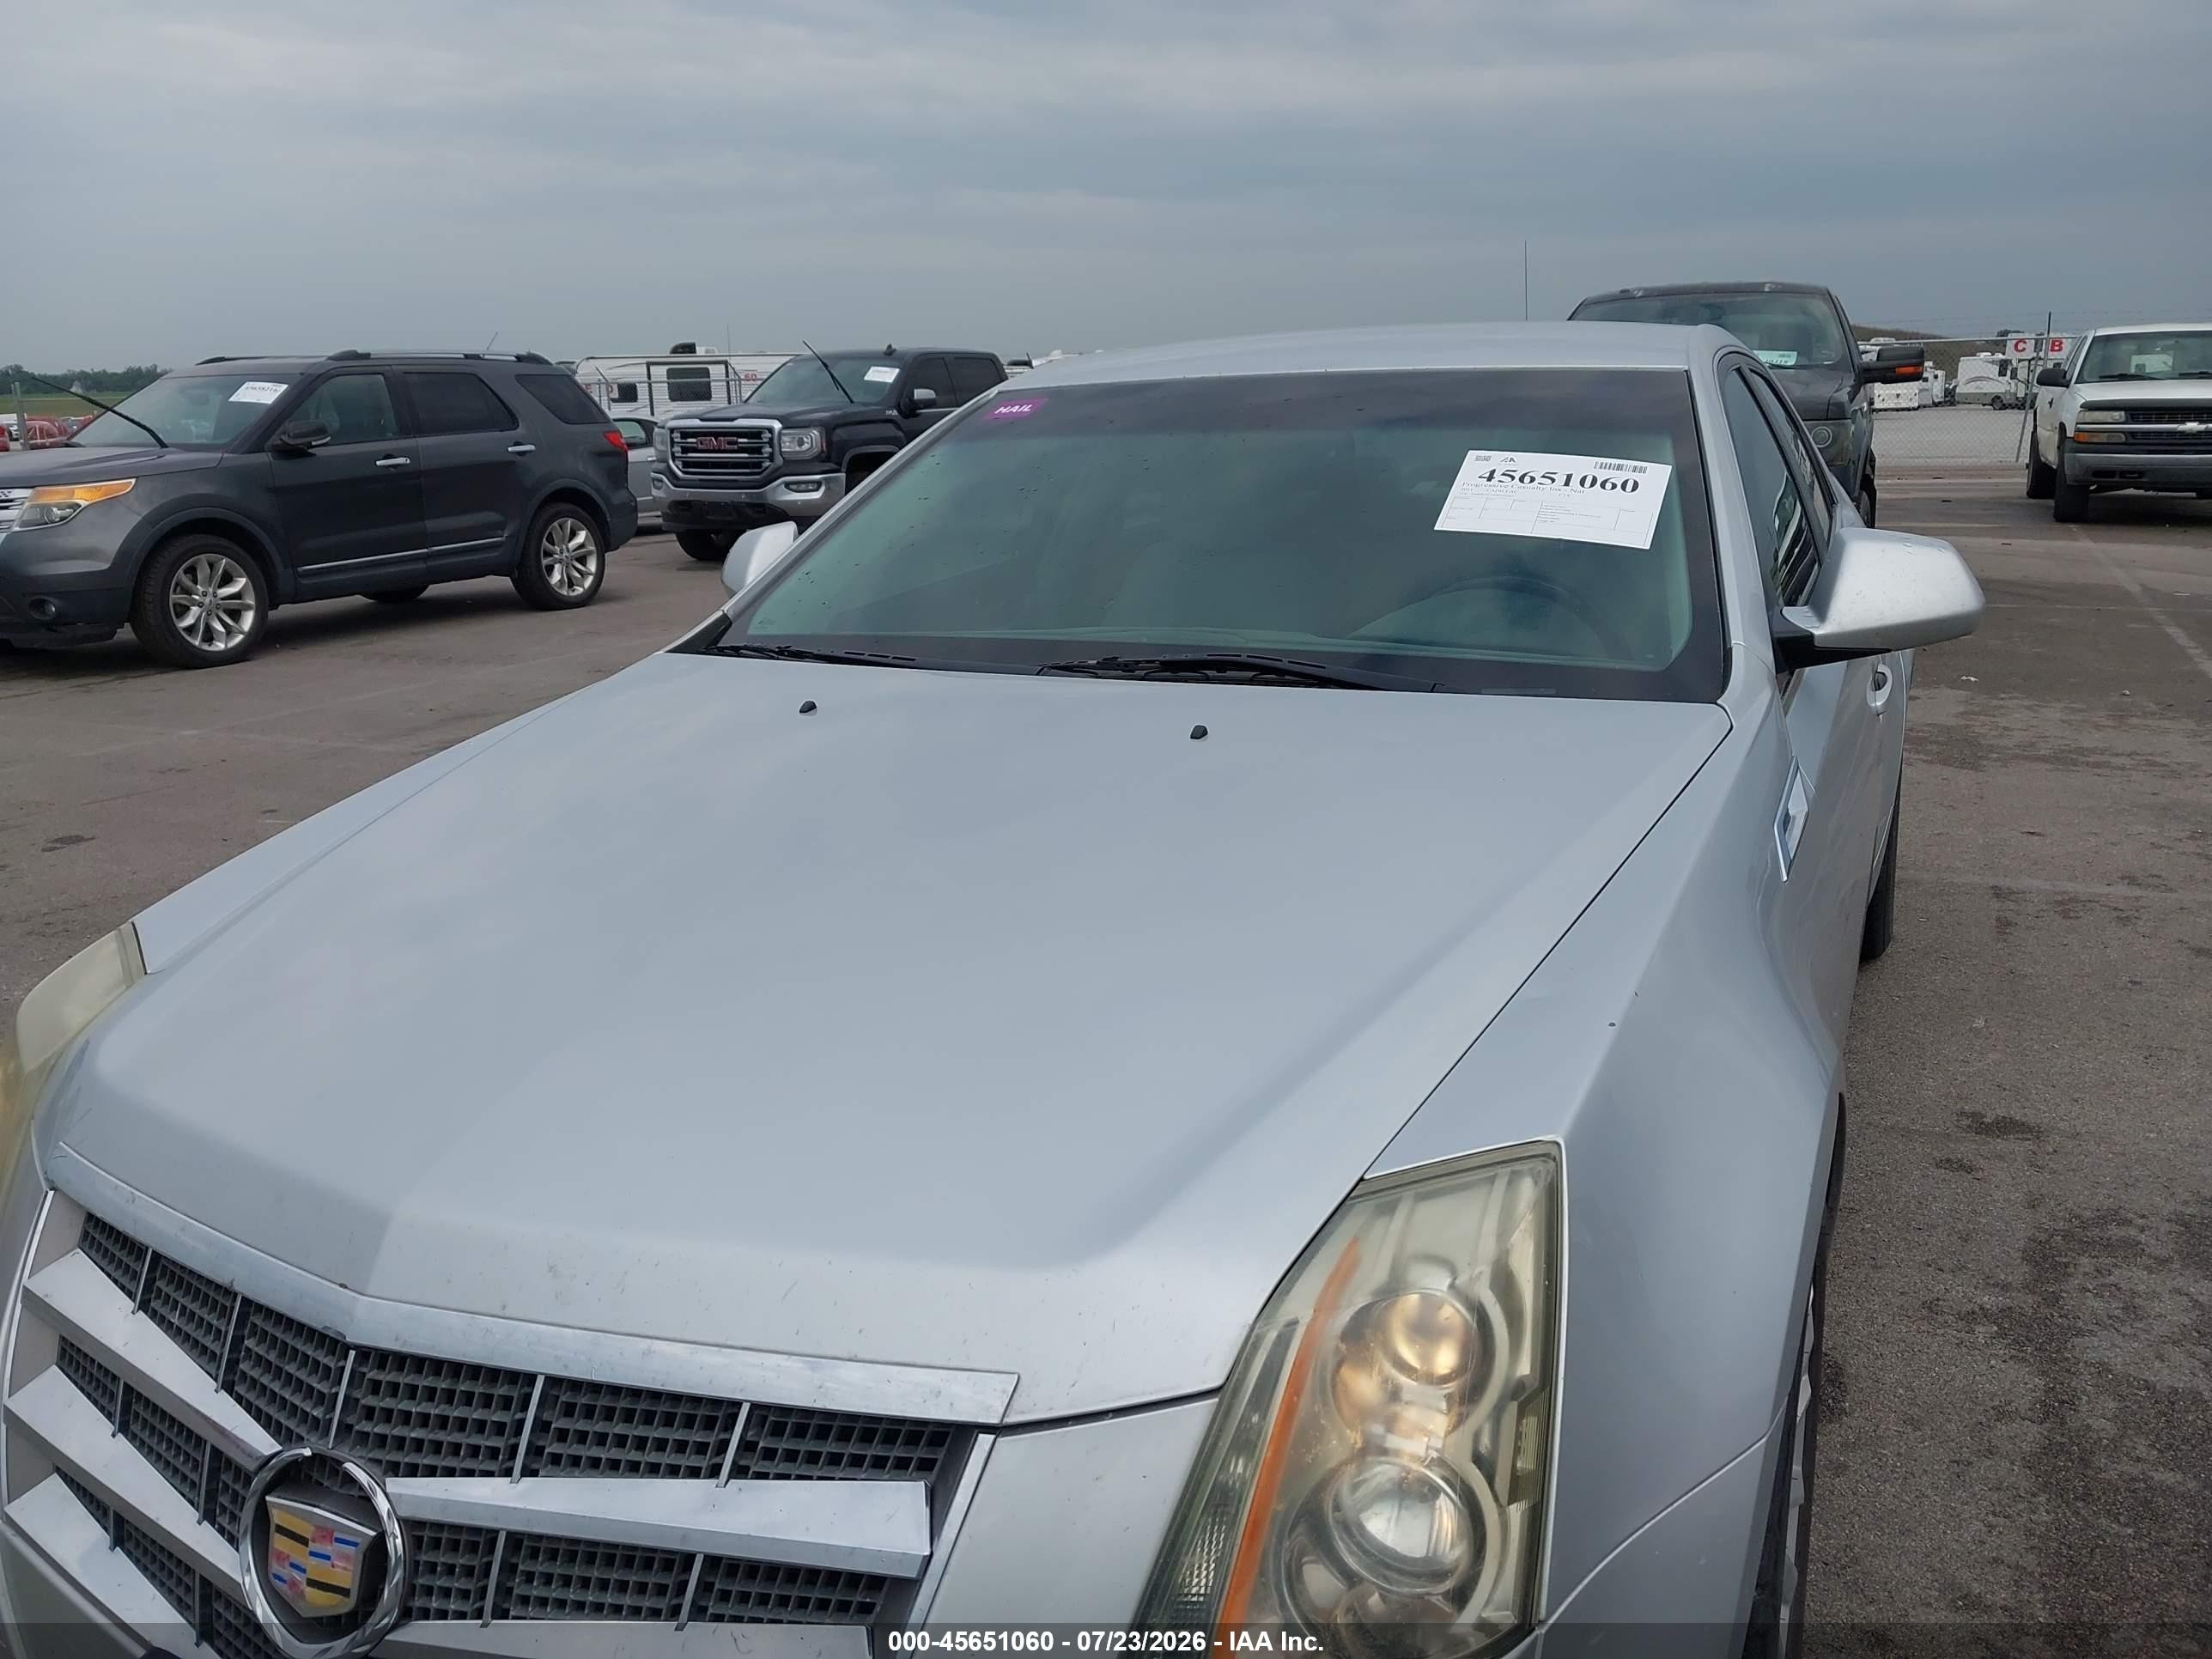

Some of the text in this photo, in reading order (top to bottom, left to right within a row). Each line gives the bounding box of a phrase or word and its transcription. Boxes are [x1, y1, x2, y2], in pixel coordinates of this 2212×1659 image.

[2014, 340, 2027, 352] C
[2050, 339, 2063, 352] B
[994, 404, 1032, 414] HAIL
[696, 436, 738, 450] GMC
[1478, 468, 1639, 494] 45651060
